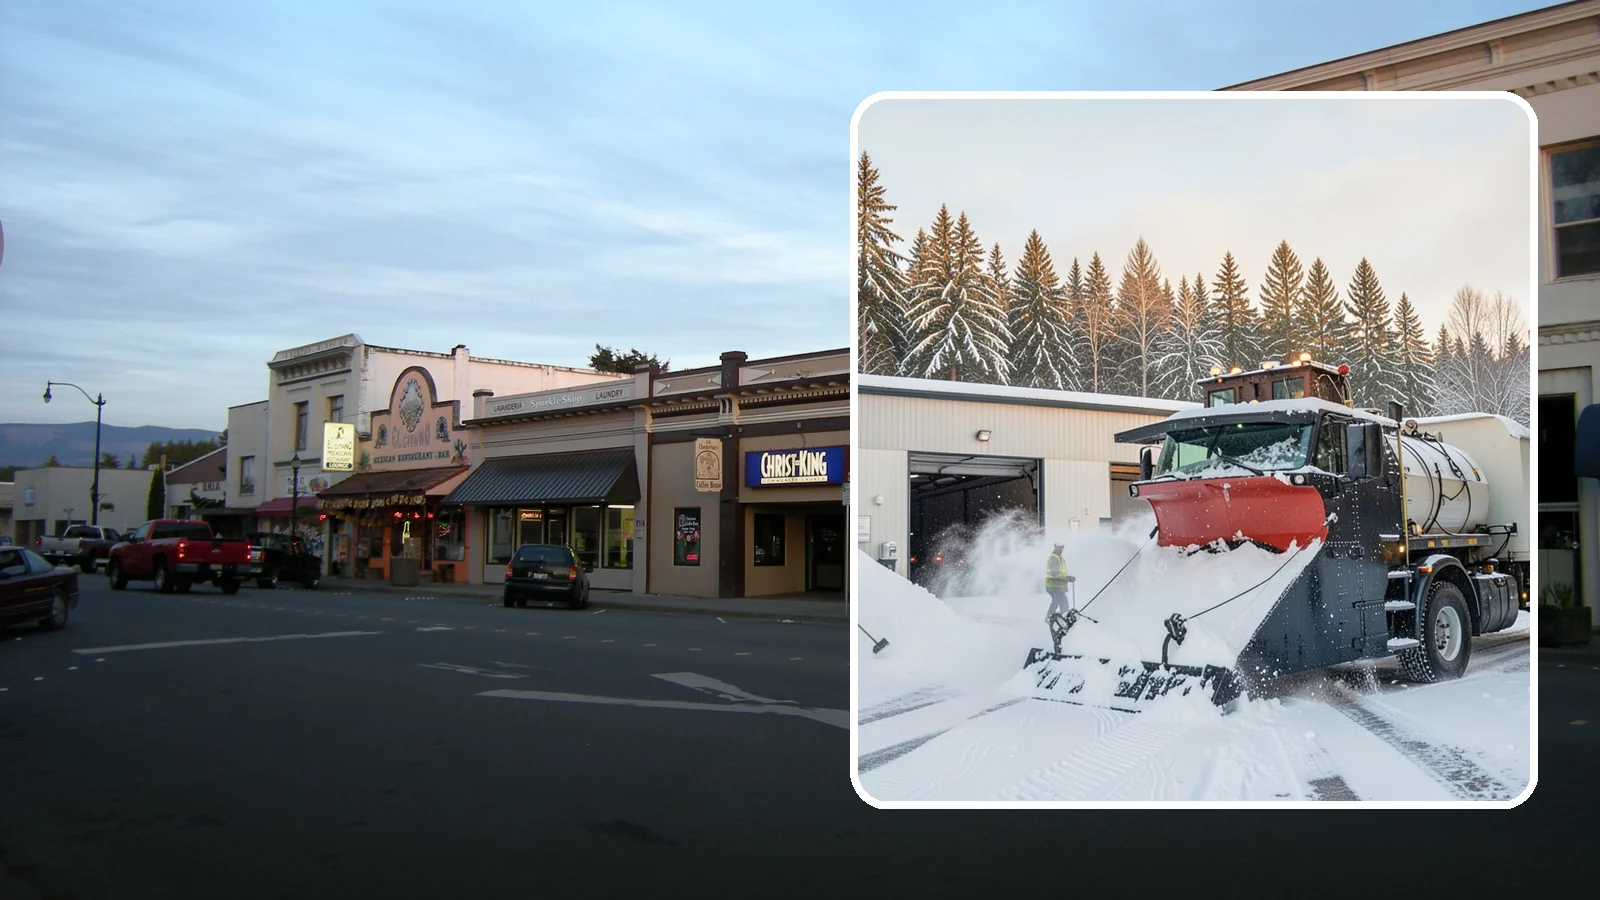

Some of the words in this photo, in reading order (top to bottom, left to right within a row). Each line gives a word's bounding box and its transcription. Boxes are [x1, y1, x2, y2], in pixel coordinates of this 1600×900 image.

[530, 396, 561, 409] Sparkle
[562, 394, 582, 404] Shop
[595, 389, 623, 400] LAUNDRY
[493, 401, 523, 413] LAVANDERIA
[374, 455, 396, 464] MEXICAN
[397, 451, 433, 462] RESTAURANT
[438, 450, 450, 459] BAR
[761, 452, 796, 478] CHRIST
[799, 450, 827, 476] KING
